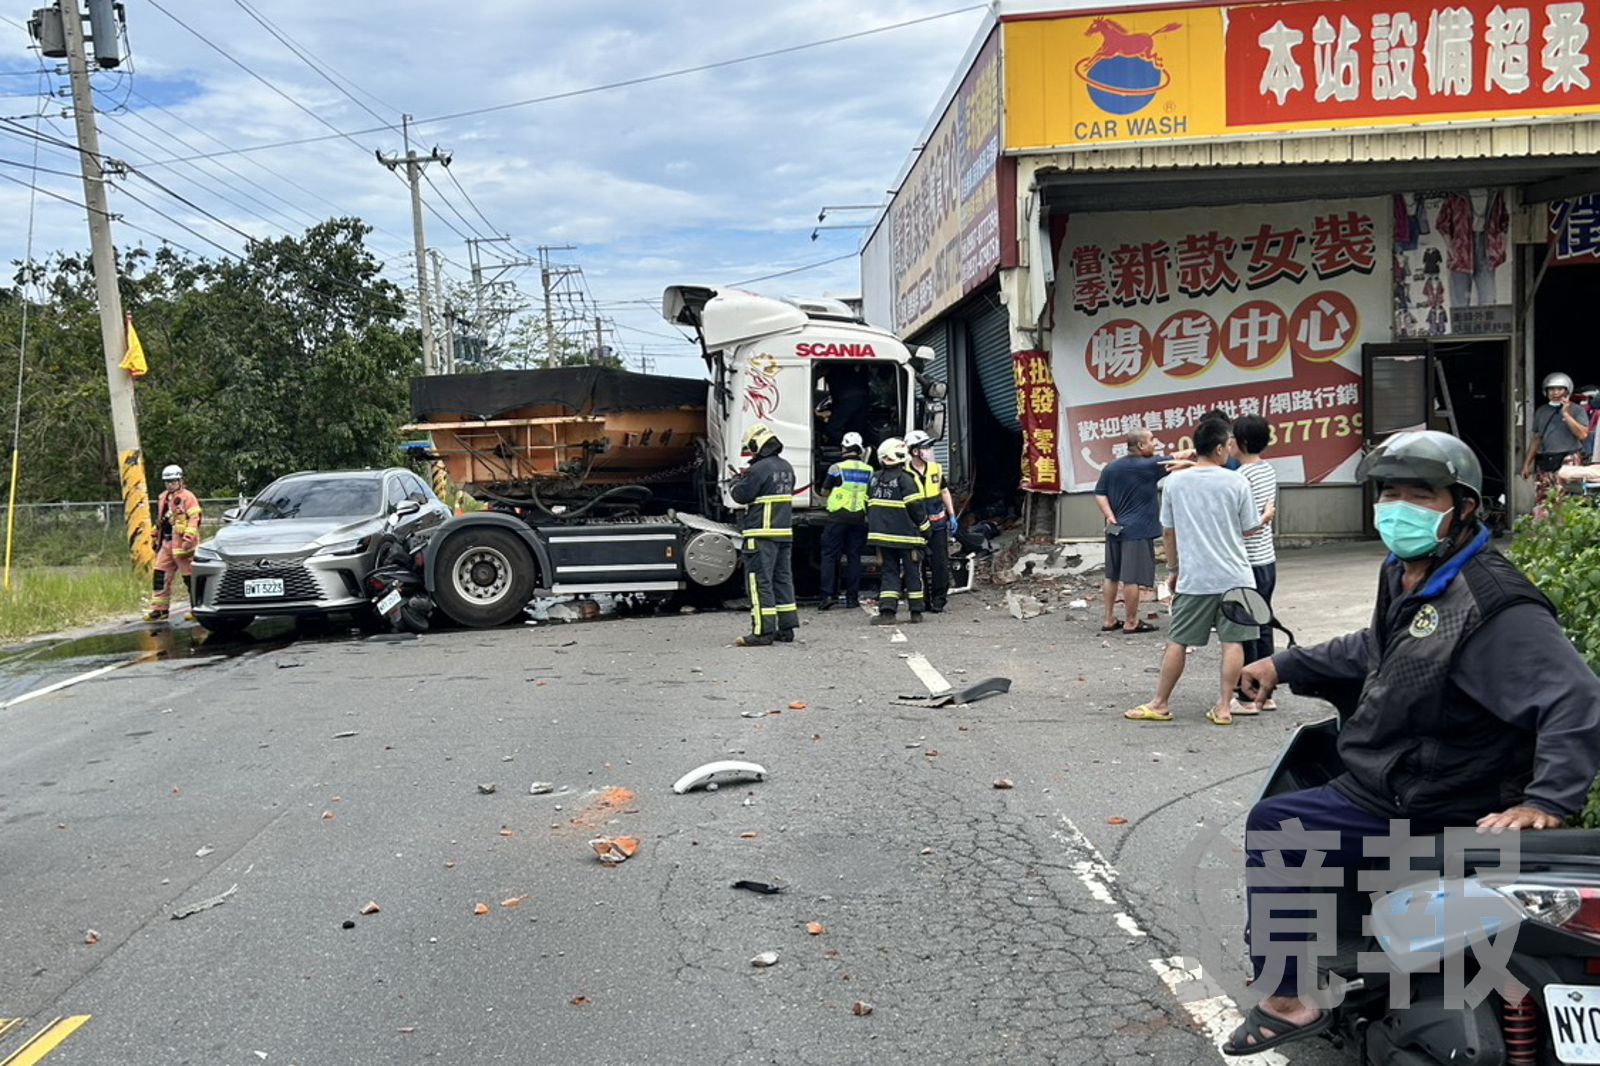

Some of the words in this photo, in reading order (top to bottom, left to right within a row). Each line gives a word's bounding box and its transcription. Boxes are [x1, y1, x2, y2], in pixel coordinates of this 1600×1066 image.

[1258, 2, 1590, 106] 本站設備超柔
[1074, 119, 1118, 140] CAR
[1126, 116, 1187, 136] WASH
[795, 342, 876, 357] SCANIA
[1090, 299, 1352, 381] 暢貨中心
